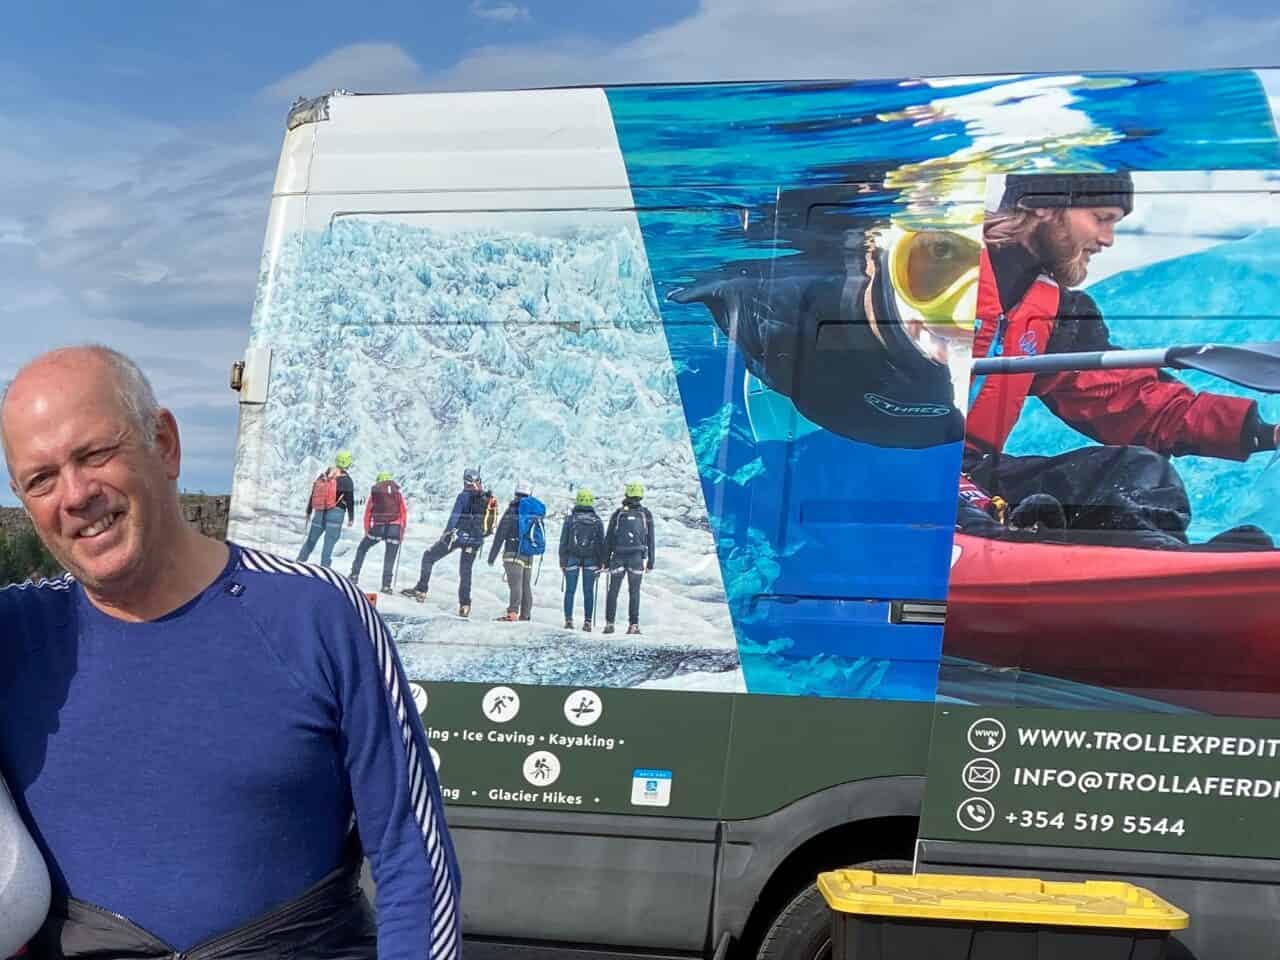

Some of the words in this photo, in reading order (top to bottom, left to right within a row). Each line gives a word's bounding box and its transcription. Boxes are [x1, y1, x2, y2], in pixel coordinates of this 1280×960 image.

[424, 726, 449, 742] ing
[463, 729, 484, 742] Ice
[487, 730, 535, 746] Caving
[548, 733, 615, 750] Kayaking
[1017, 727, 1280, 757] WWW.TROLLEXPEDIT
[489, 788, 540, 804] Glacier
[542, 791, 583, 805] Hikes
[1005, 810, 1065, 830] +354
[1074, 813, 1114, 832] 519
[1123, 815, 1186, 837] 5544
